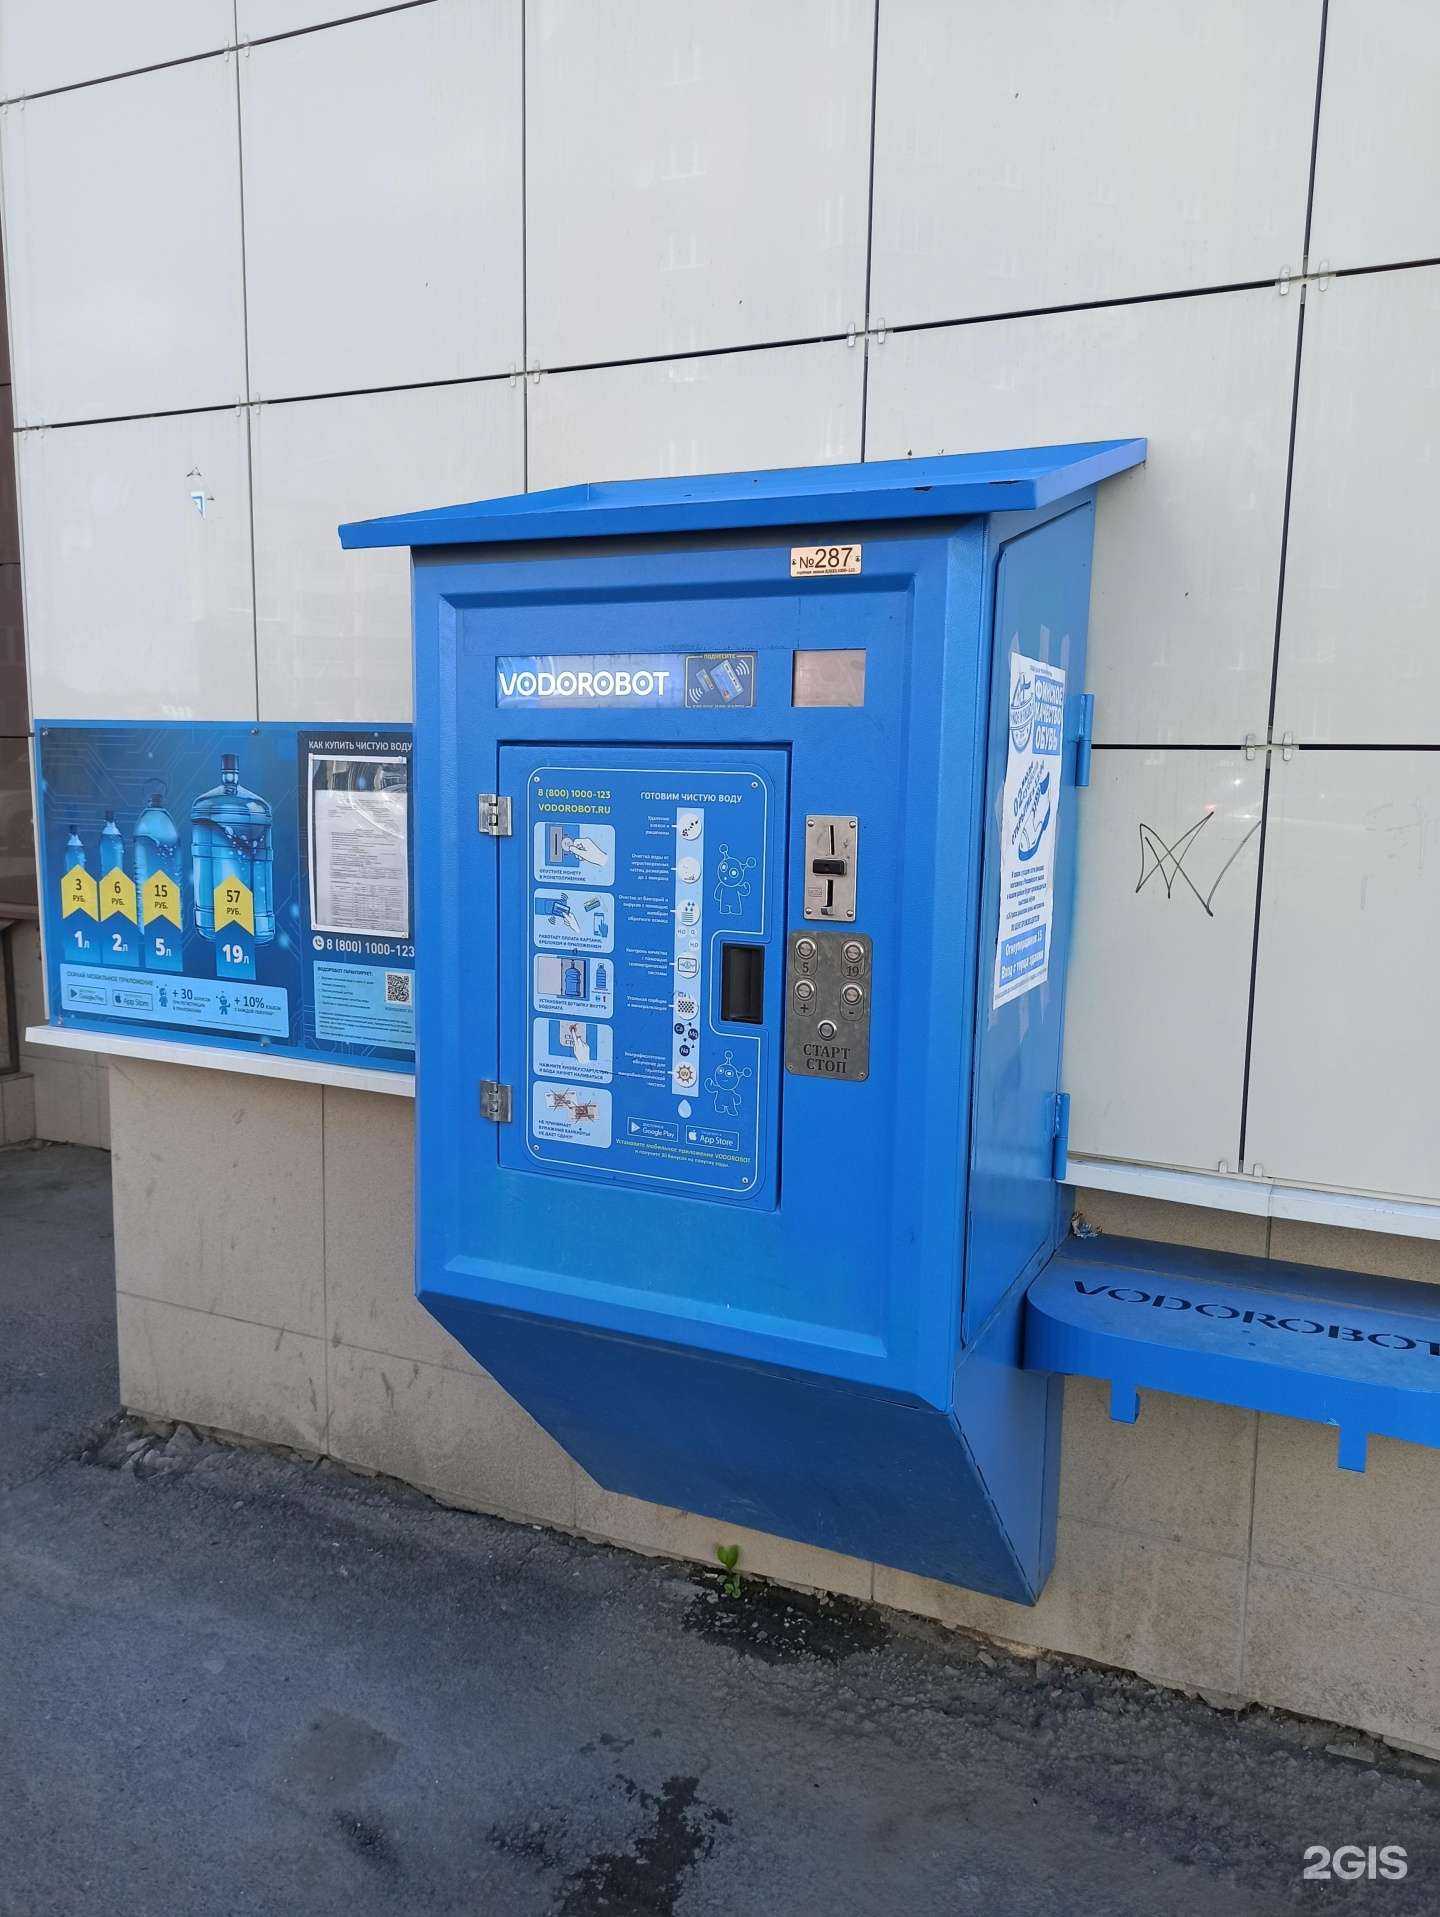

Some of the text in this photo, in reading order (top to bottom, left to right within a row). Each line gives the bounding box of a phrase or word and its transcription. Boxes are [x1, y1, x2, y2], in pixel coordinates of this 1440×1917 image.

[499, 671, 670, 697] VODOROBOT
[308, 741, 412, 752] КАК КУПИТЬ ЧИСТУЮ ВОДУ
[537, 788, 611, 799] 8 (800) 1000-123
[640, 791, 742, 804] ГОТОВИМ ЧИСТУЮ ВОДУ
[538, 803, 611, 814] VODOROBOT.RU
[75, 878, 82, 891] 3
[114, 881, 121, 894] 6
[154, 884, 168, 897] 15
[226, 889, 241, 903] 57
[226, 907, 241, 915] РУБ.
[327, 938, 415, 957] 8 (800) 1000-123
[802, 962, 809, 973] 5
[181, 988, 193, 1000] 30
[244, 995, 265, 1009] 10%
[803, 1043, 850, 1060] СТАРТ
[806, 1057, 847, 1073] СТОП
[642, 1127, 675, 1138] Google Play
[699, 1135, 734, 1147] App Store
[1073, 1280, 1440, 1357] VODOROBOT
